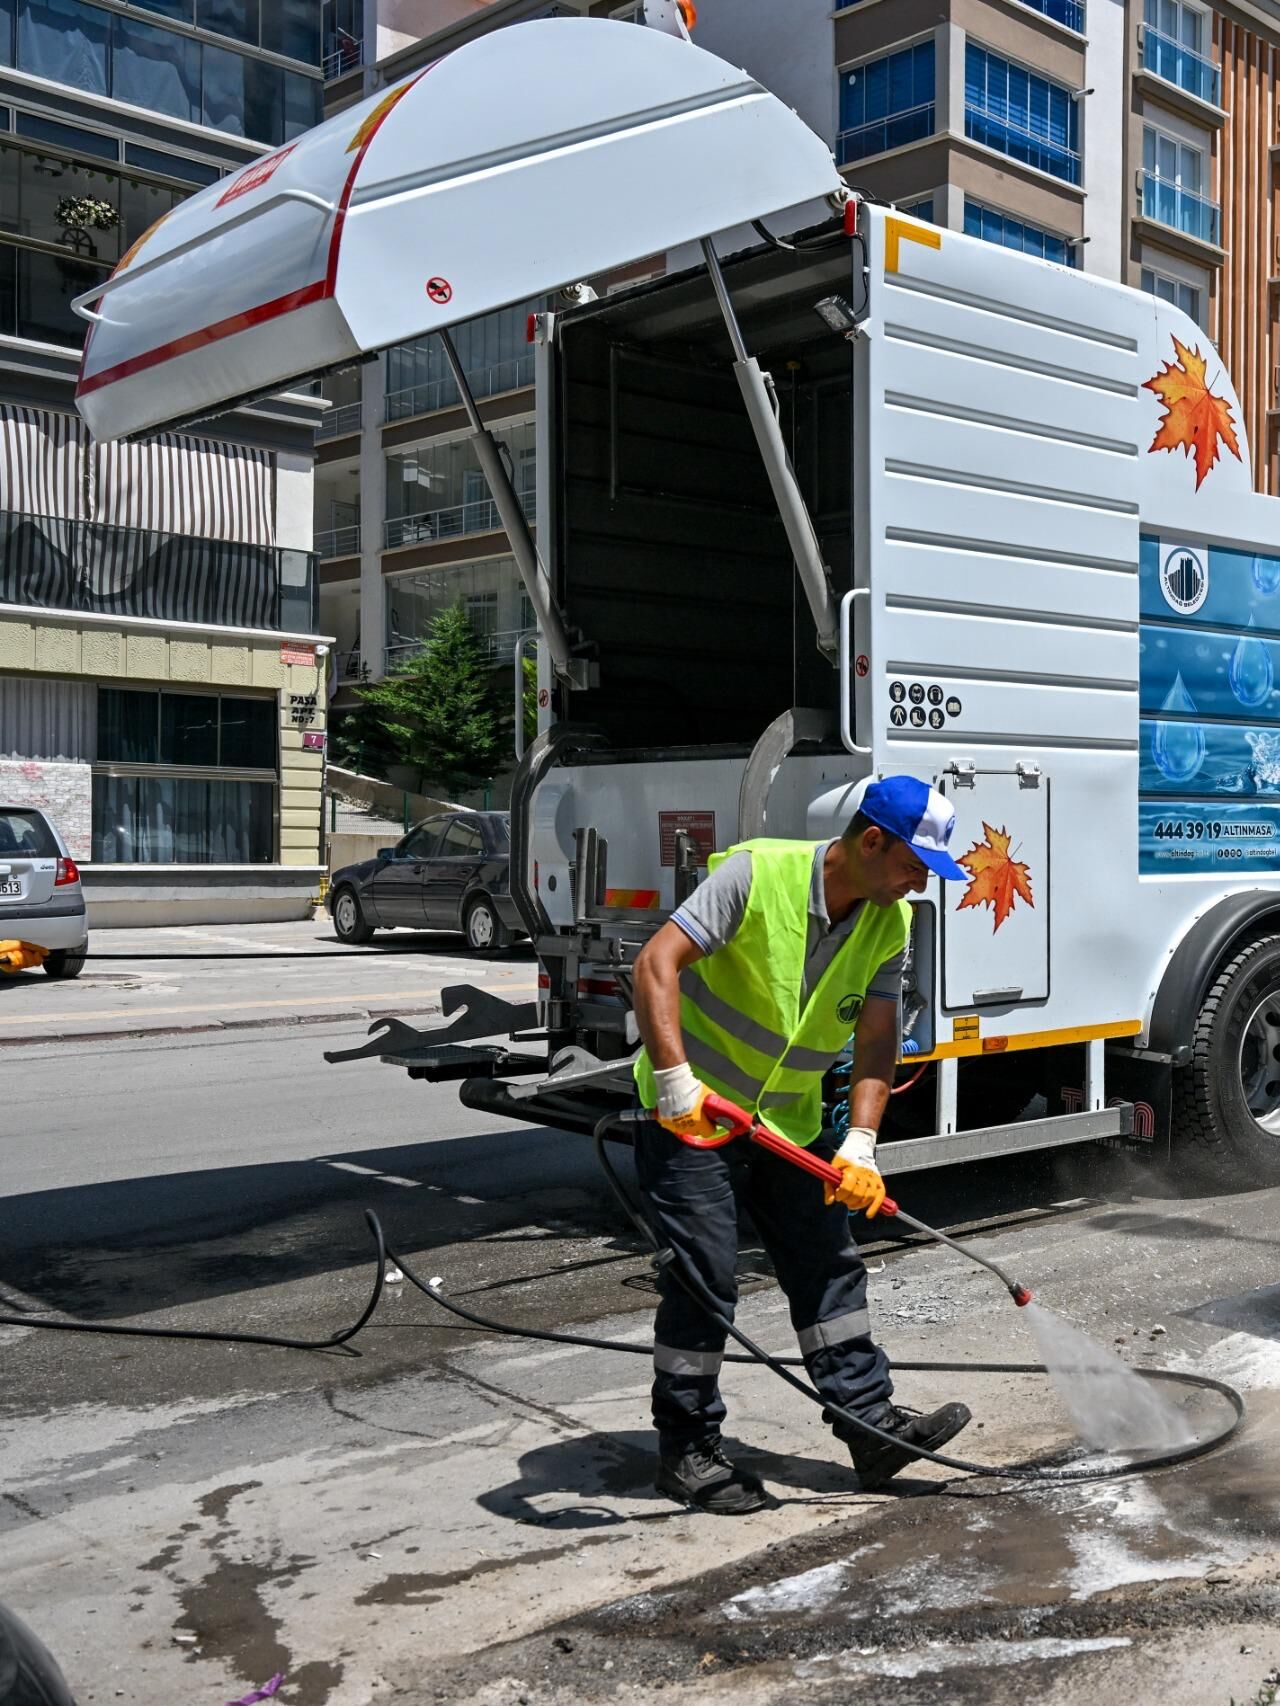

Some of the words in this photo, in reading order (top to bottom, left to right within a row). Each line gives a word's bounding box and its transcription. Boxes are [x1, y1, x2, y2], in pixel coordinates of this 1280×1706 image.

[311, 736, 317, 744] 7
[1155, 822, 1184, 839] 444
[1186, 822, 1204, 839] 39
[1206, 822, 1222, 839] 19
[1224, 825, 1272, 836] ALTINMASA
[0, 882, 20, 893] 613
